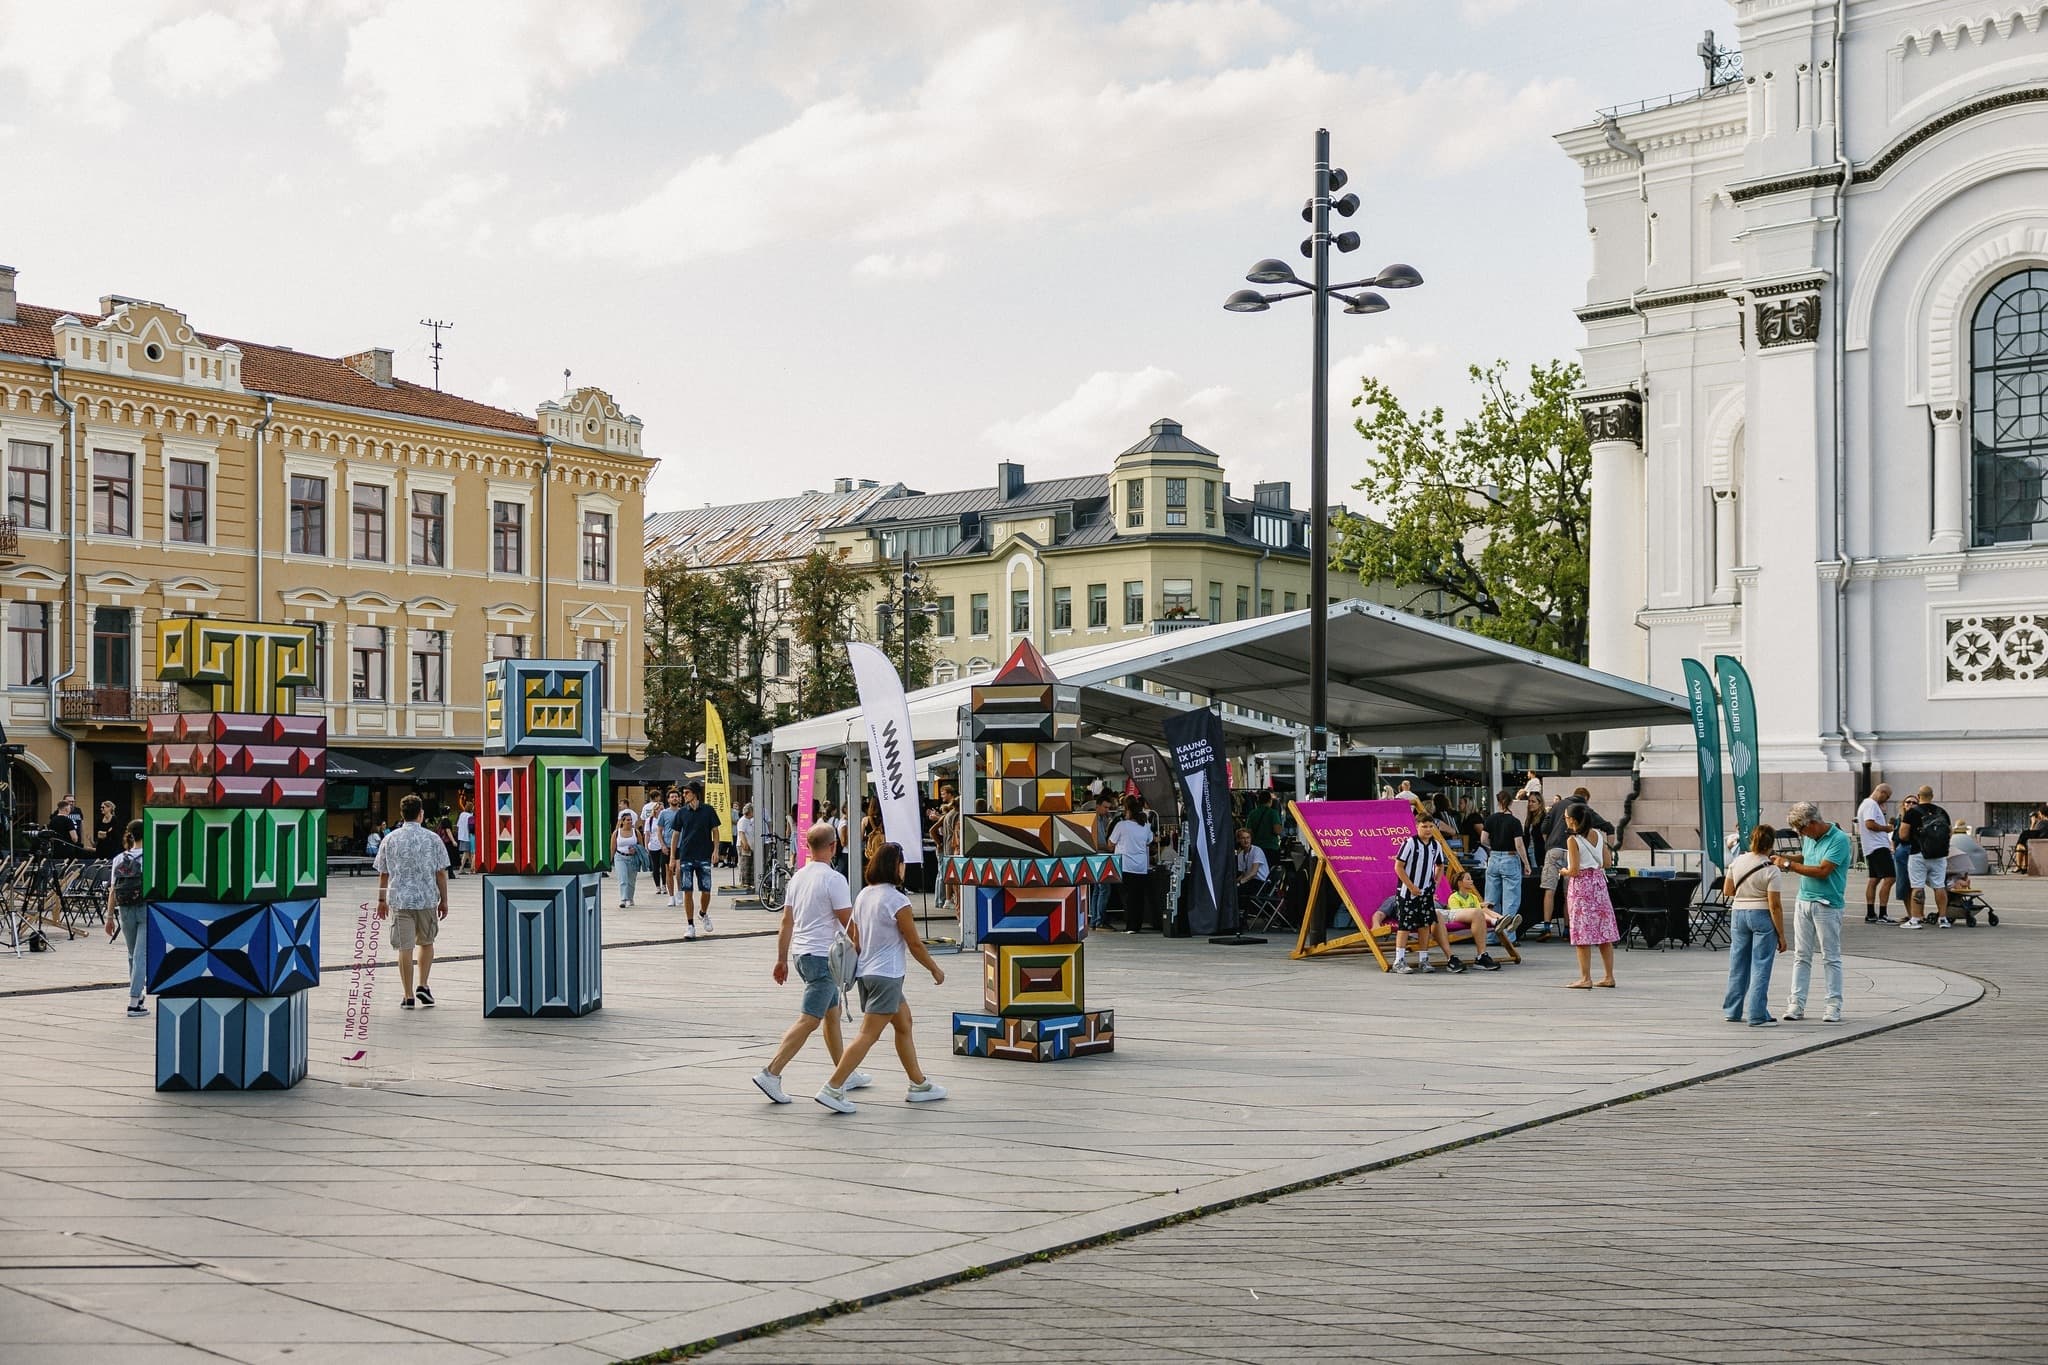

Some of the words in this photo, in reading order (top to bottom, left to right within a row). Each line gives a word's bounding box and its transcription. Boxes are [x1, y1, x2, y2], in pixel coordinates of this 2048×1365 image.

[1176, 738, 1207, 755] KAUNO
[1178, 753, 1189, 763] IX
[1315, 828, 1354, 837] KAUNO
[1358, 826, 1411, 837] KULTŪROS
[1320, 837, 1352, 847] MUGĖ
[343, 963, 362, 1039] TIMOTIEJUS
[354, 902, 369, 959] NORVILA
[357, 984, 375, 1041] (MORFAI)
